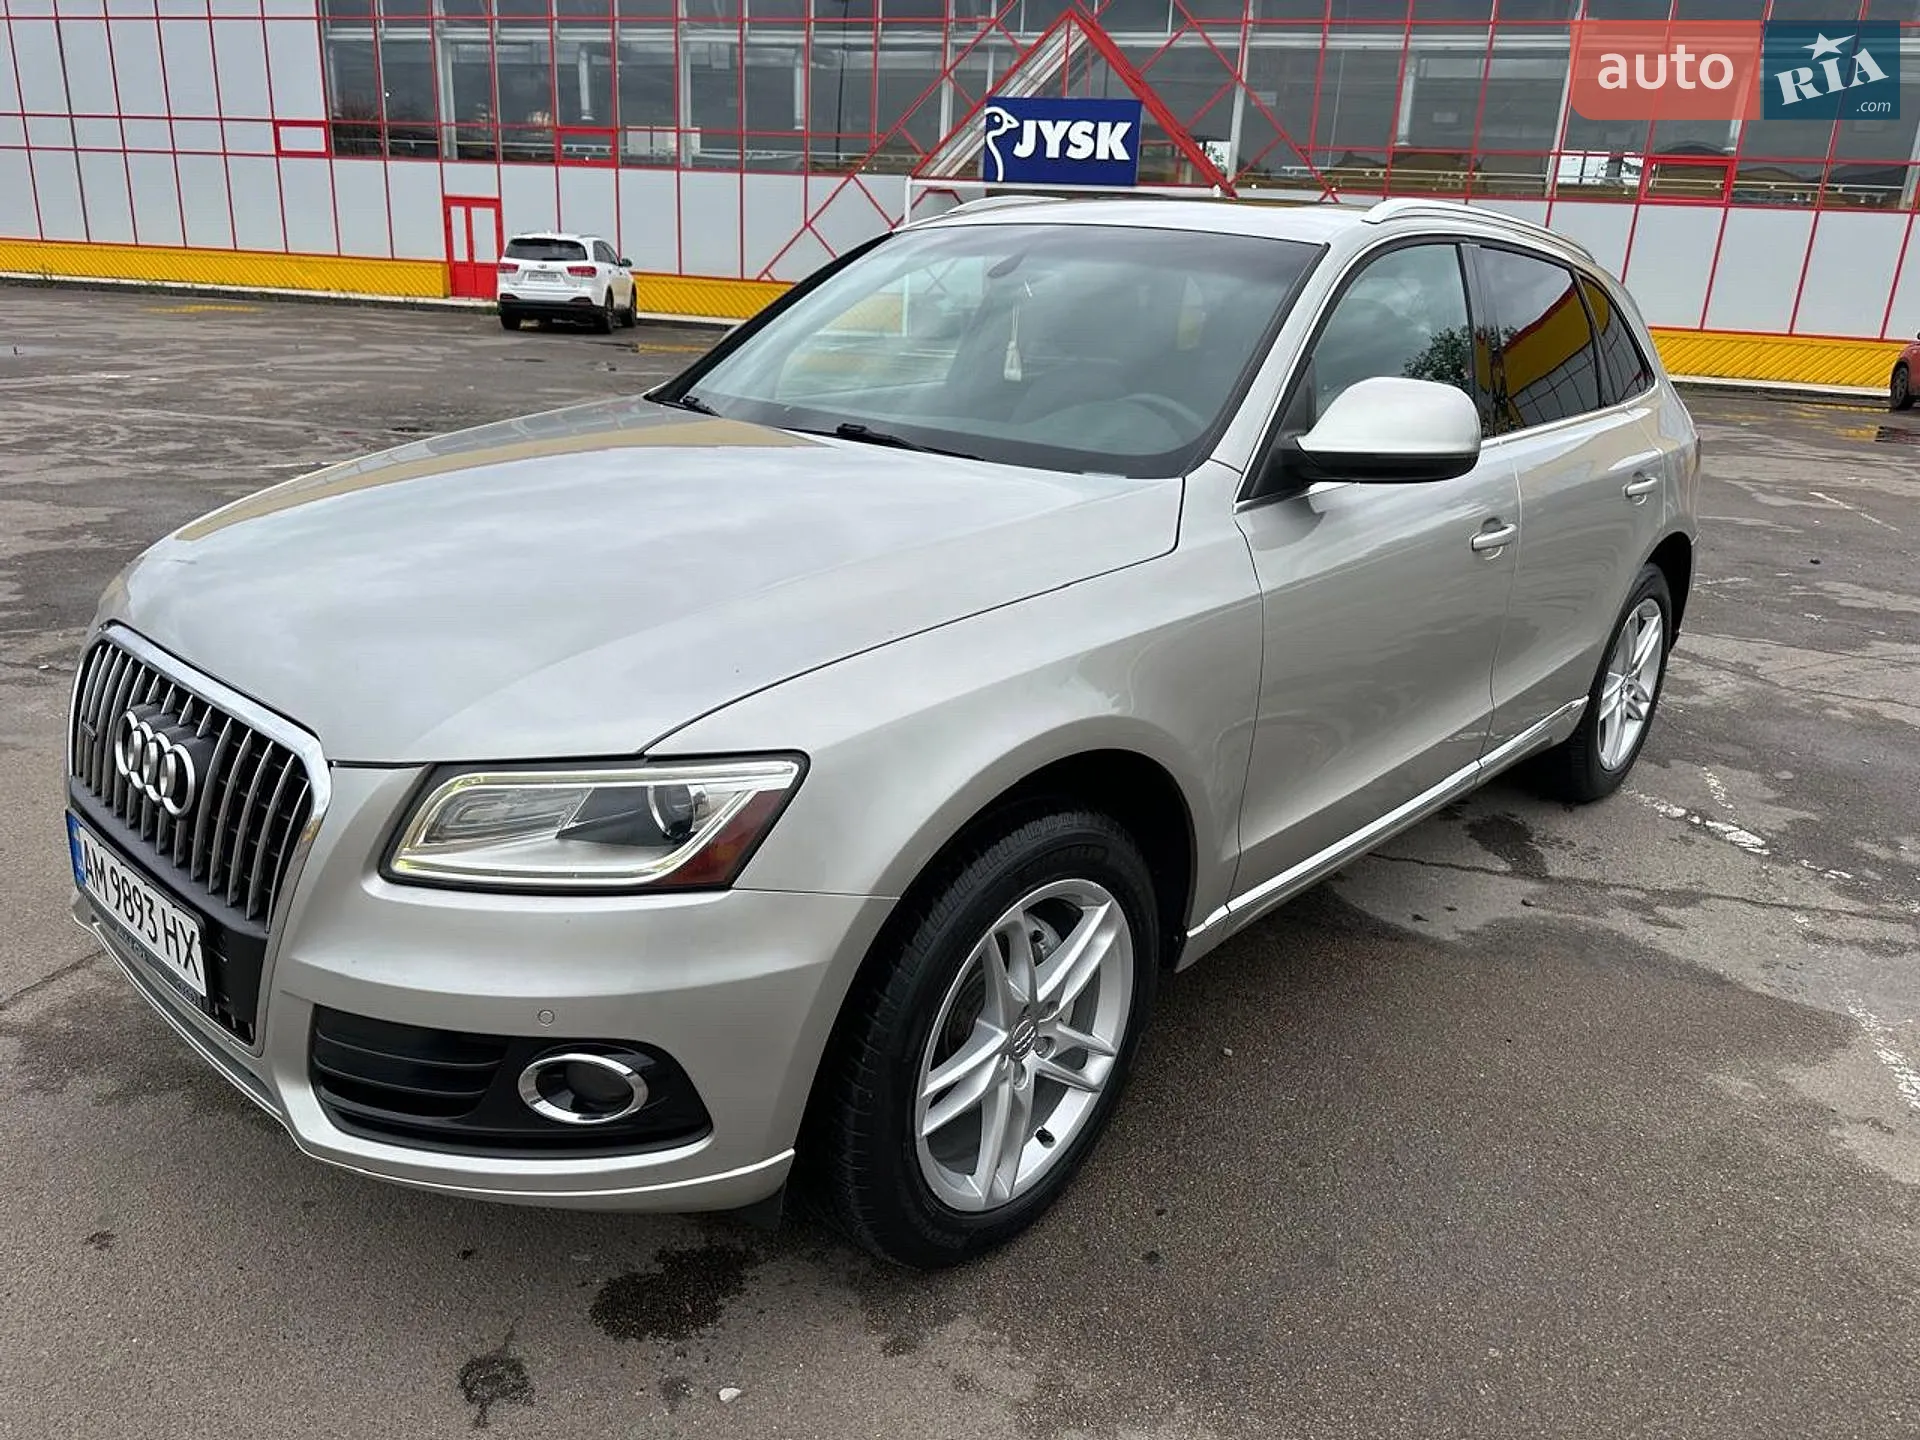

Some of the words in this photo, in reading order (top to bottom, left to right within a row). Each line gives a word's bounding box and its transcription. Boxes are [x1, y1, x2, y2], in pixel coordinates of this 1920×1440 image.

[1012, 119, 1133, 161] JYSK
[84, 839, 110, 902] AM
[110, 865, 158, 945] 9893
[161, 907, 201, 982] HX
